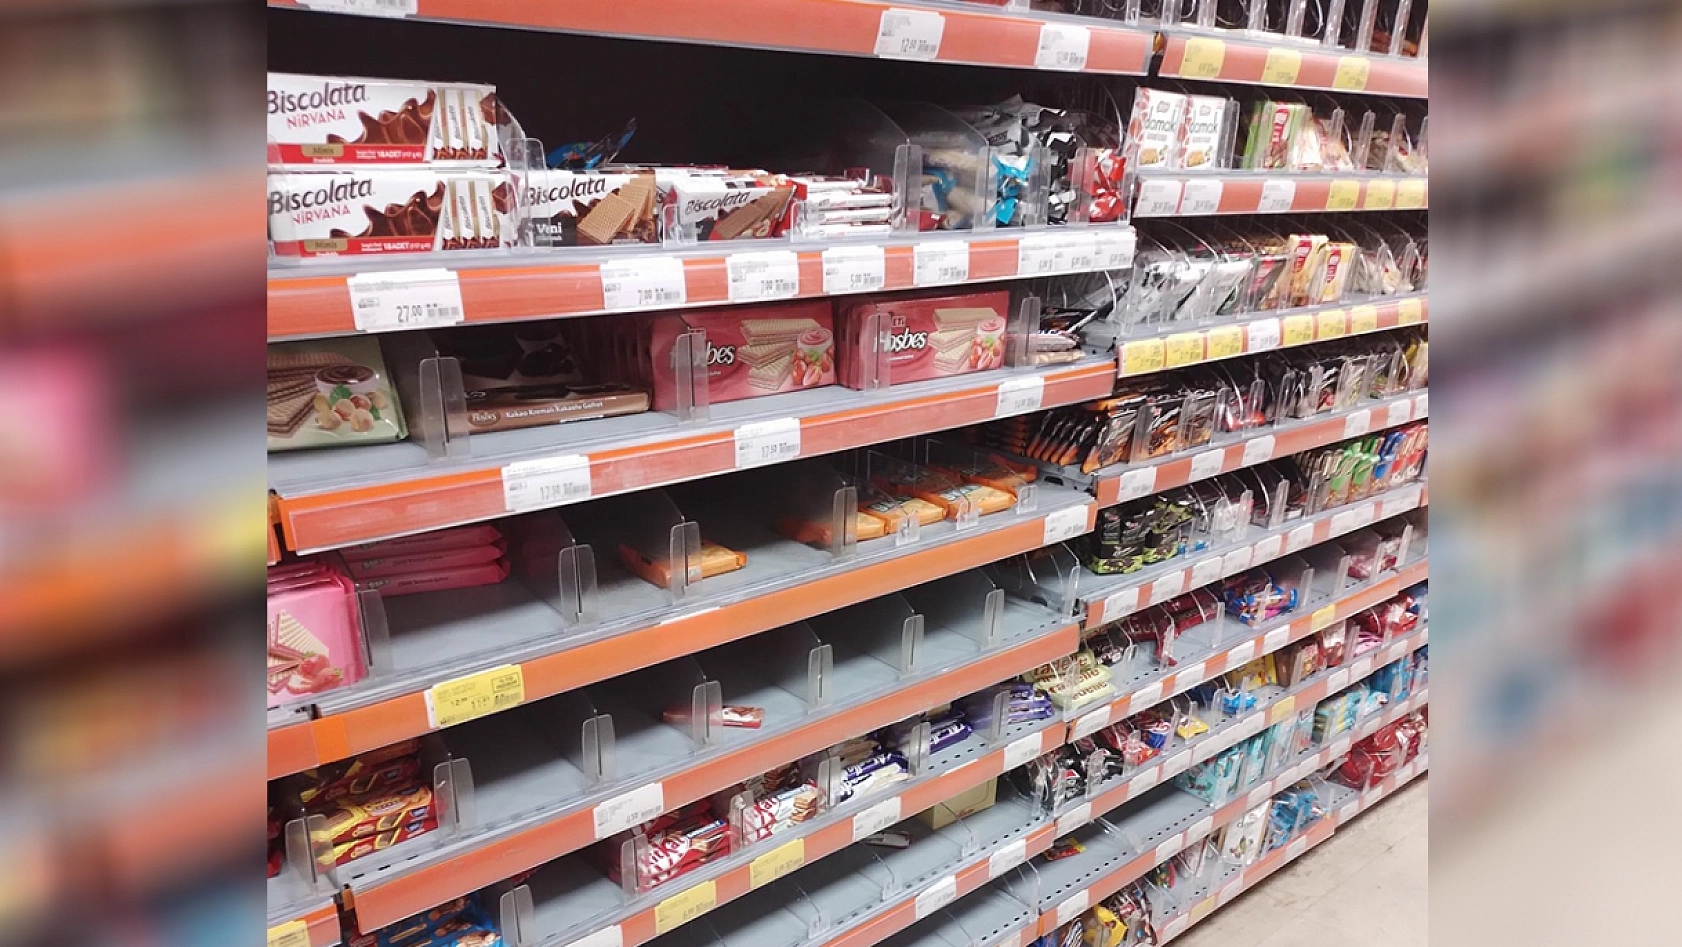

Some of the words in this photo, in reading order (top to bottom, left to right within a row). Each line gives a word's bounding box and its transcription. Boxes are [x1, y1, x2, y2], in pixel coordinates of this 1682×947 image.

[267, 82, 367, 114] Biscolata
[269, 178, 373, 215] Biscolata
[527, 177, 606, 206] Biscolata
[685, 191, 750, 214] Biscolata
